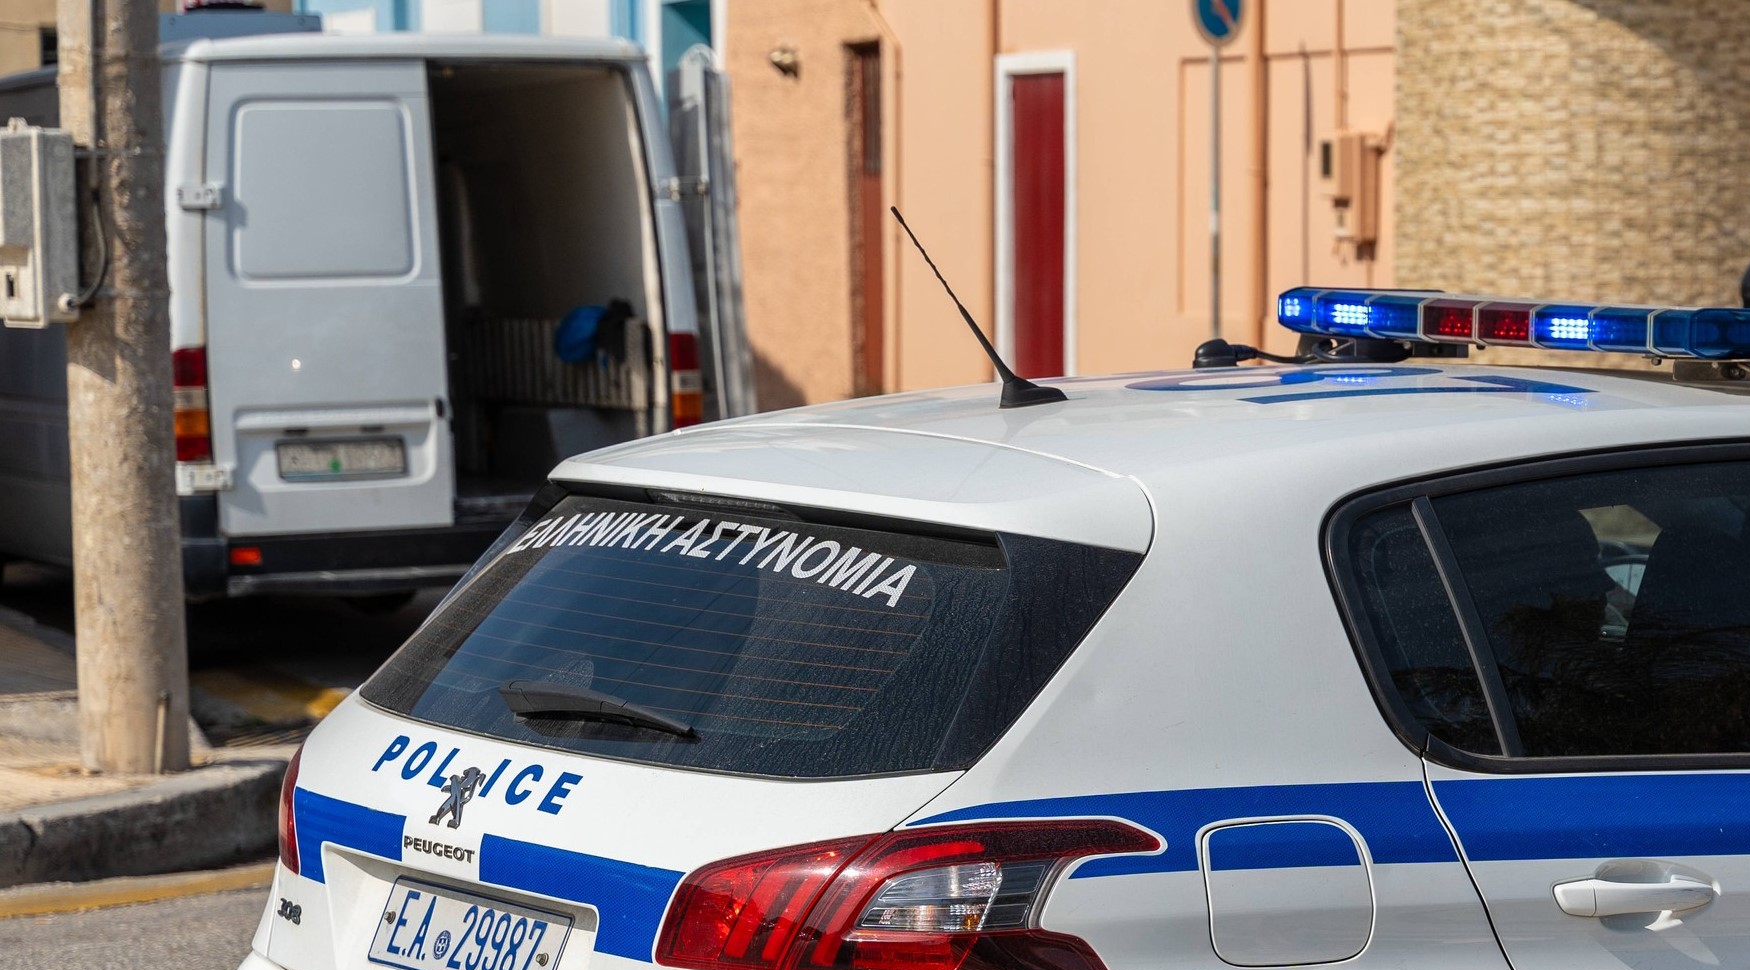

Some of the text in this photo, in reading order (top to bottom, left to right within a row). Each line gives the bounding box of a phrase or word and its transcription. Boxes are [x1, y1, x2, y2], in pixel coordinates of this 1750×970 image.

[508, 512, 918, 608] ΕΛΛΗΝΙΚΗ ΑΣΤΥΝΟΜΙΑ
[371, 735, 584, 816] POLICE
[403, 835, 476, 865] PEUGEOT
[276, 897, 303, 926] 308
